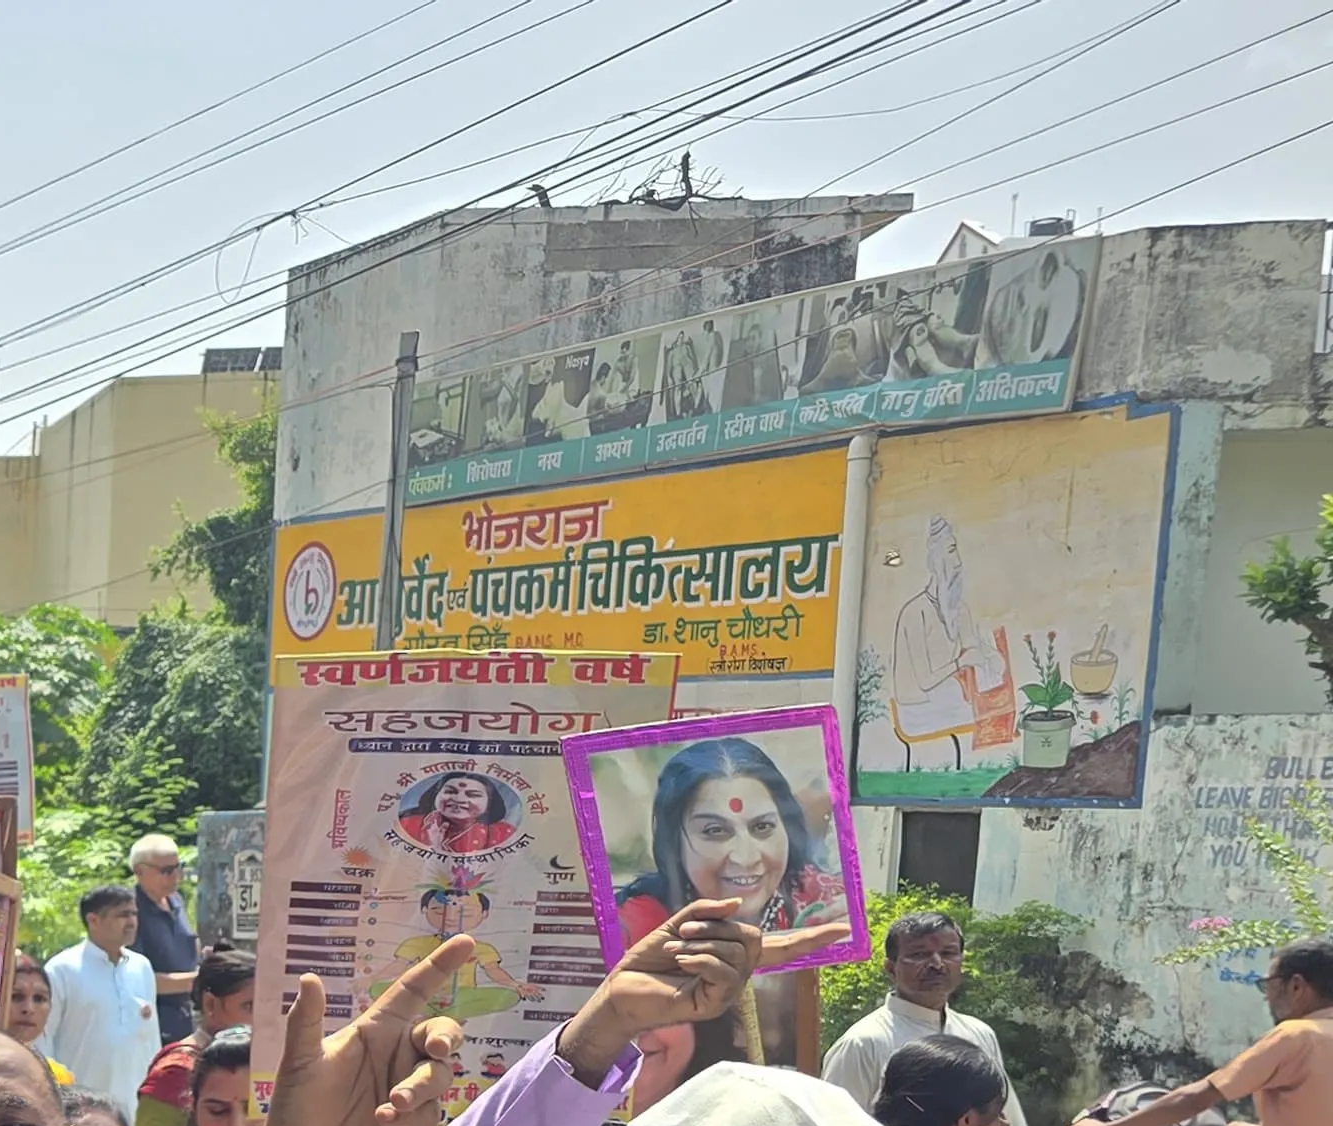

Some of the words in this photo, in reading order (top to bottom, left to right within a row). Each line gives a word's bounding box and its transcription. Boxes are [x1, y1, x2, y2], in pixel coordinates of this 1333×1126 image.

[462, 499, 612, 556] भोजराज
[673, 617, 721, 648] शानु
[725, 603, 804, 642] चौधरी
[297, 651, 555, 687] स्वर्णजयंती
[570, 652, 652, 686] वर्ष
[324, 701, 602, 736] सहजयोग
[420, 758, 478, 775] माताजी
[1194, 785, 1254, 810] LEAVE
[1210, 841, 1254, 868] YOU
